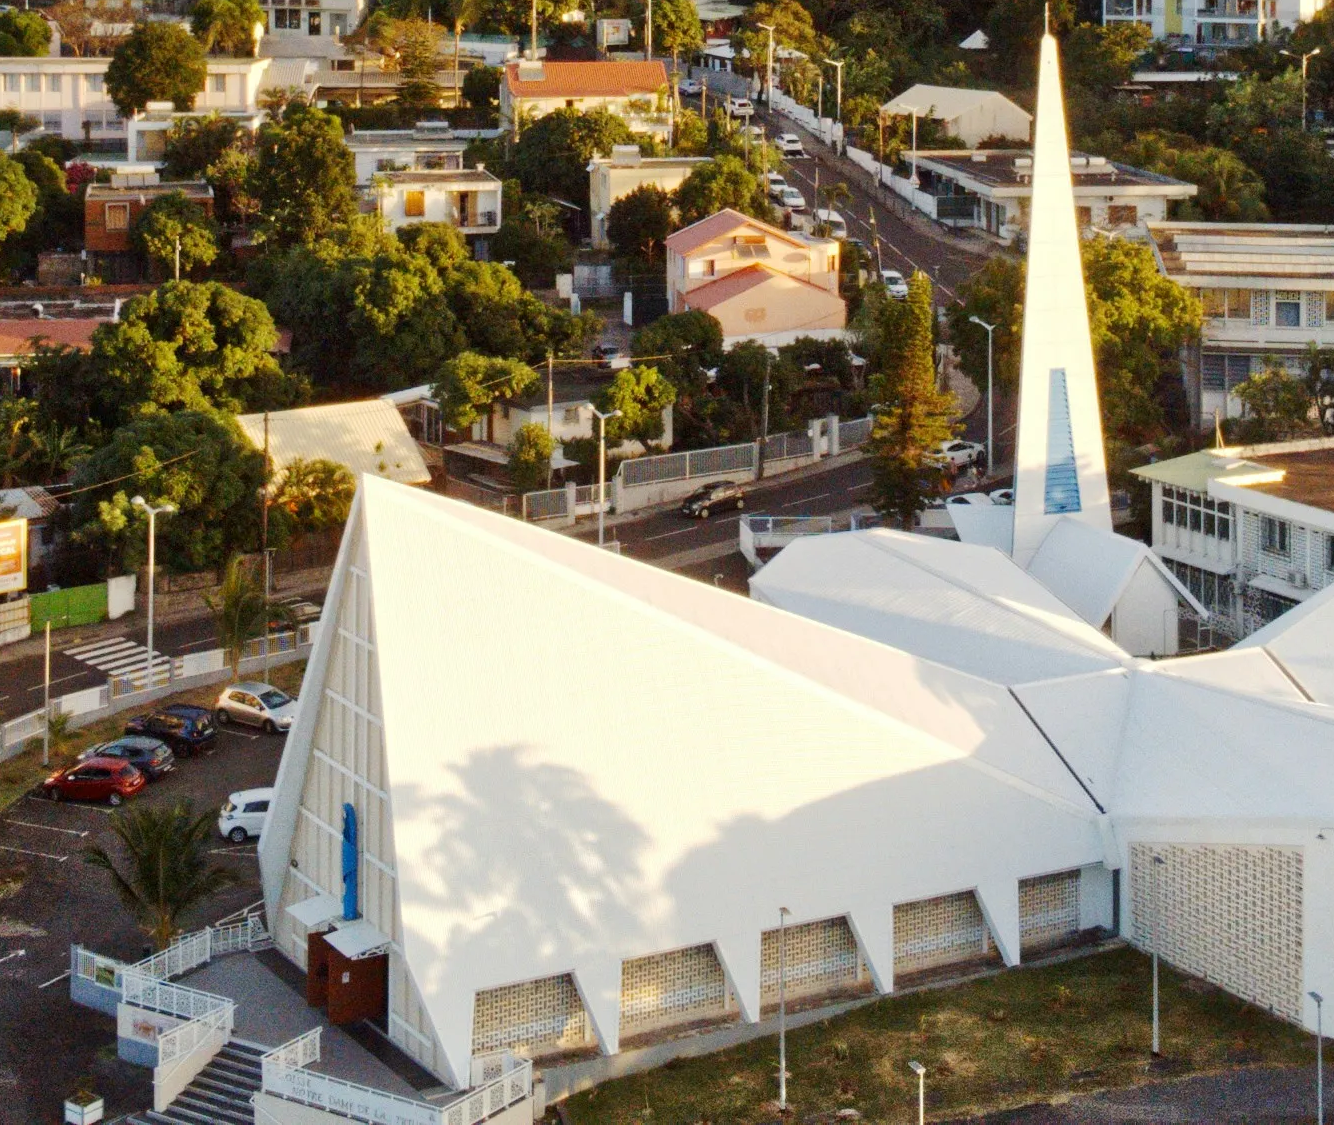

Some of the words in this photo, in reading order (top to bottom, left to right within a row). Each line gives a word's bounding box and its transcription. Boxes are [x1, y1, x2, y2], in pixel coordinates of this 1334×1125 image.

[292, 1085, 324, 1103] NOTRE
[328, 1093, 354, 1112] DAME
[357, 1103, 370, 1116] DE
[373, 1107, 387, 1121] LA
